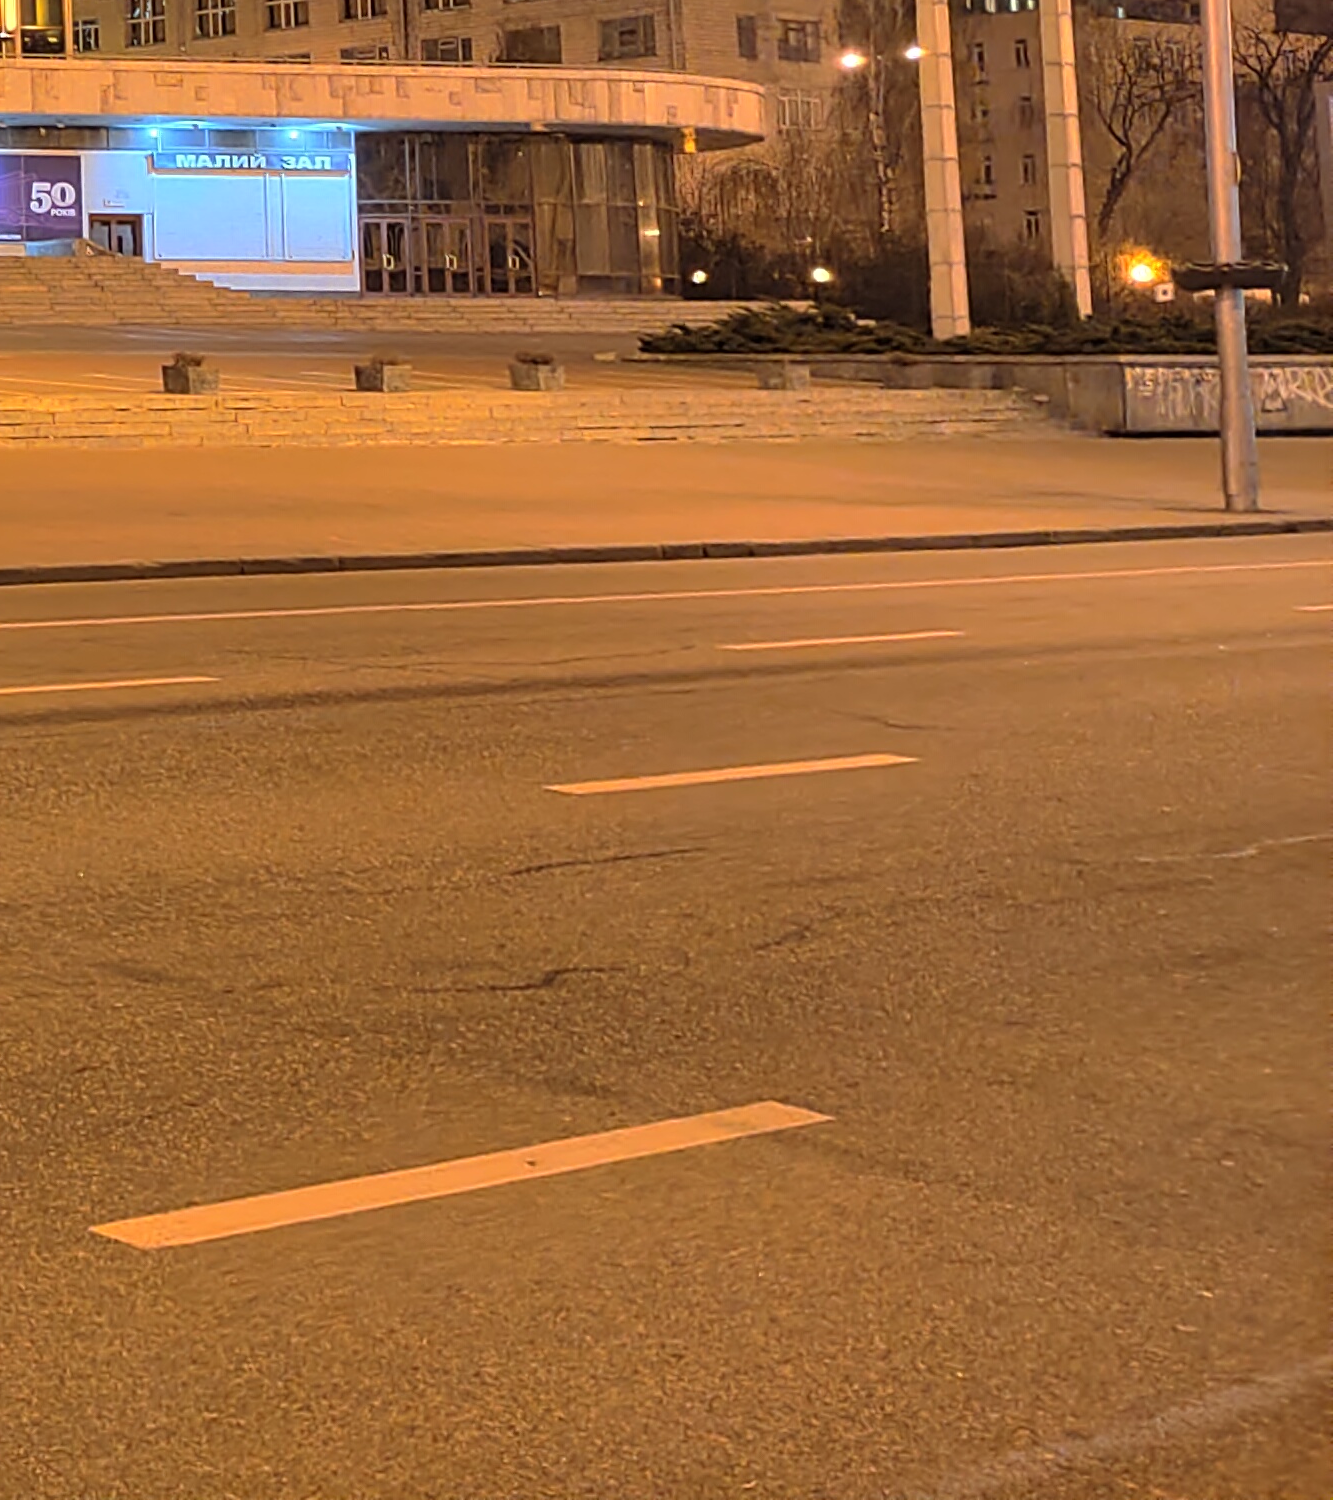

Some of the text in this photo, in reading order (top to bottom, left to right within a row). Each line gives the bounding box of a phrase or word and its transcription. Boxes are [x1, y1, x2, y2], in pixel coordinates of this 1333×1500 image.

[176, 153, 331, 169] МАЛИЙ ЗАЛ
[30, 181, 76, 213] 50
